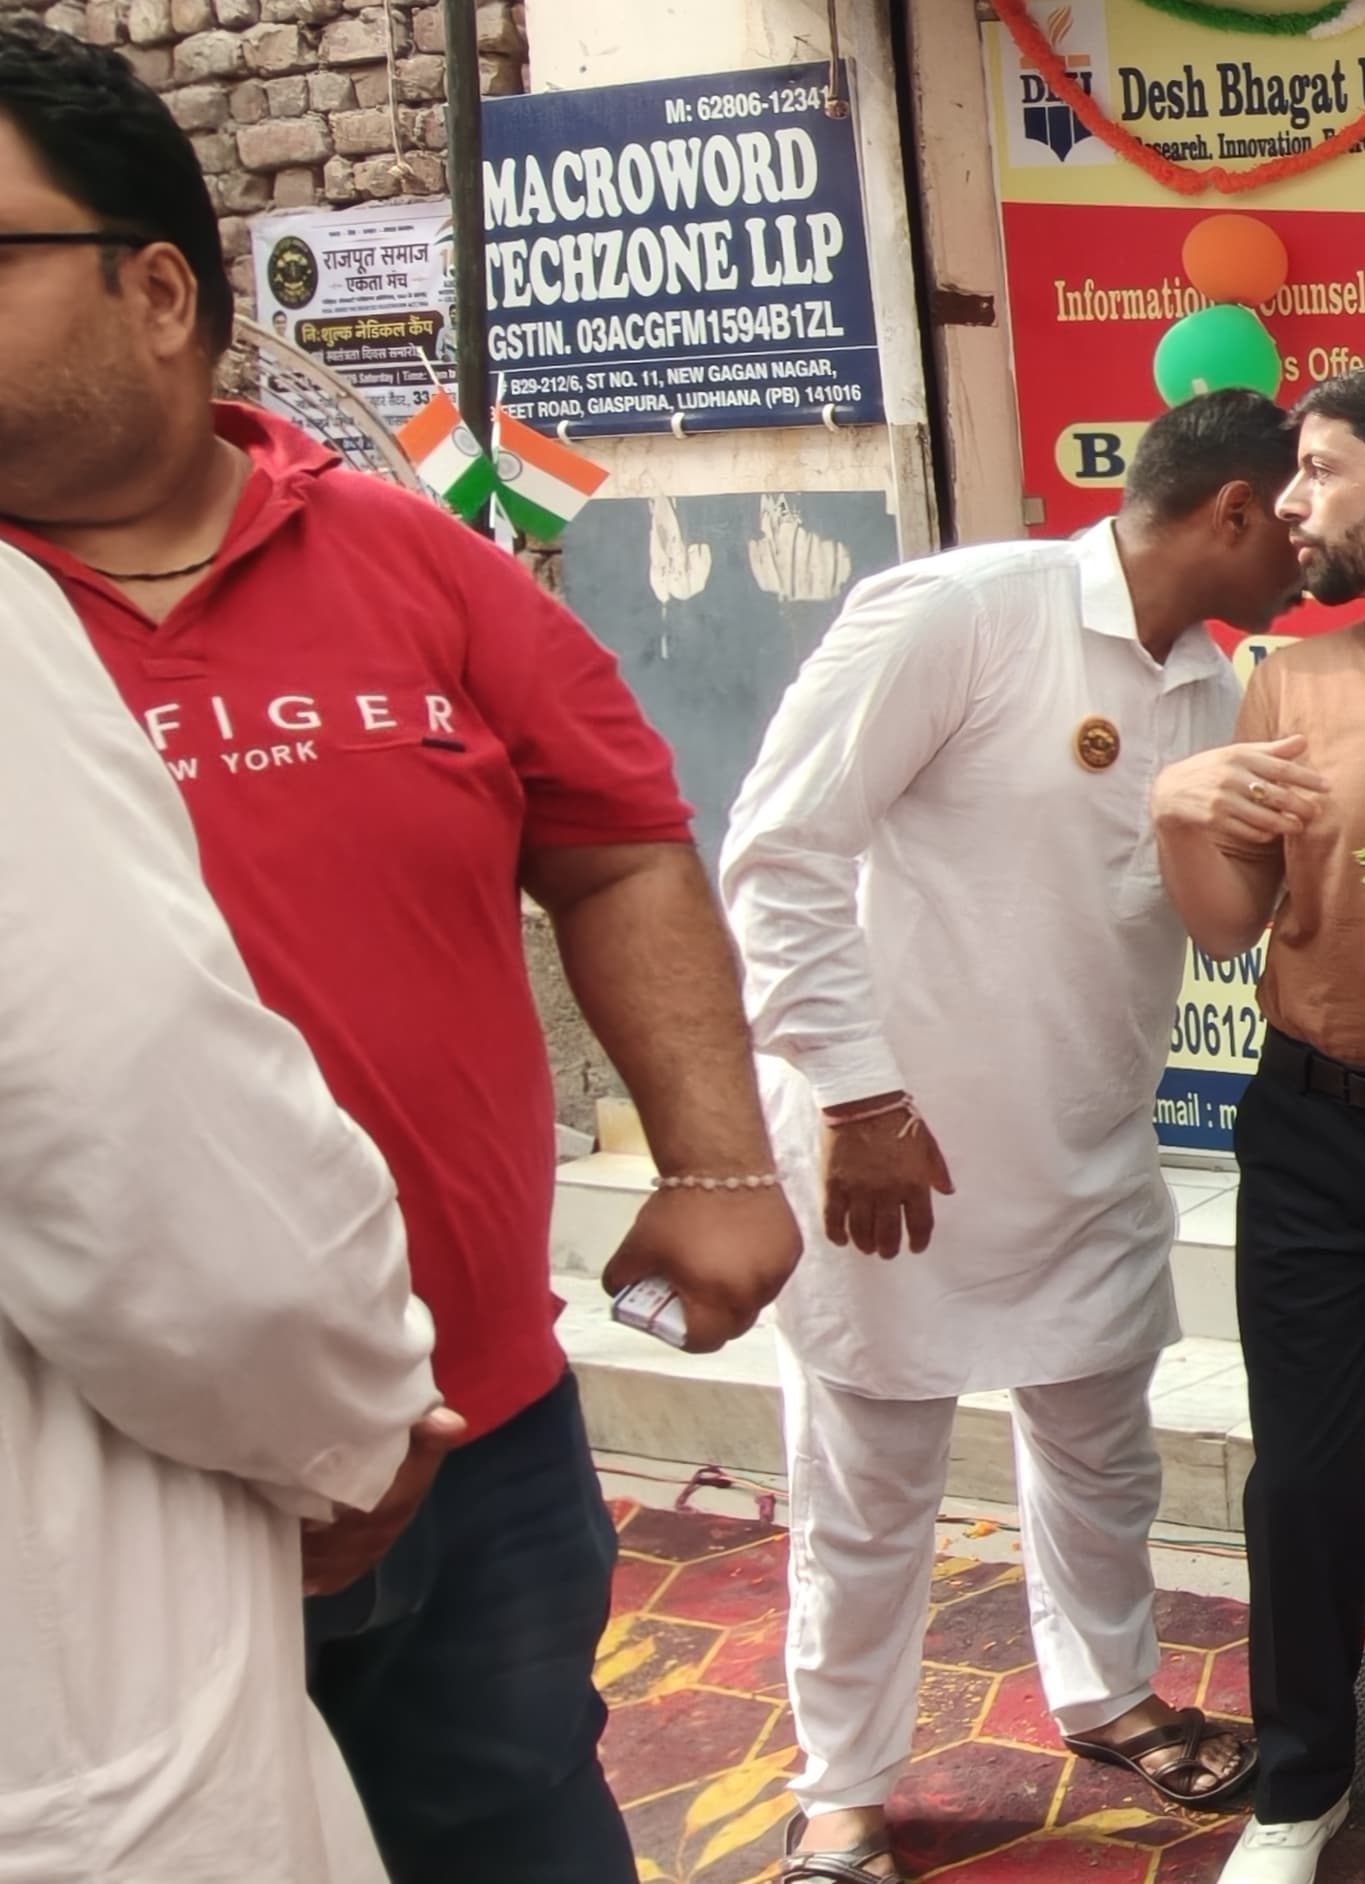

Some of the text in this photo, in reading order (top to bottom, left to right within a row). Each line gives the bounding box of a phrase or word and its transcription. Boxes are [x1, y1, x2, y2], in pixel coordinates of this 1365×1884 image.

[665, 98, 693, 124] M:
[1117, 63, 1209, 121] Desh
[1216, 59, 1349, 129] Bhagat
[482, 127, 818, 231] MACROWORD
[322, 243, 429, 273] राजपूत समाज
[485, 212, 844, 311] TECHZONE LLP
[345, 274, 384, 293] एकता
[1054, 276, 1216, 322] Informatio
[488, 300, 845, 362] GSTIN. 03ACGFM1594B1ZL
[510, 373, 583, 396] B29-212/6,
[586, 374, 605, 390] ST
[608, 372, 638, 388] NO.
[642, 369, 665, 389] 11,
[667, 367, 705, 386] NEW
[708, 364, 769, 384] GAGAN
[770, 359, 837, 381] NAGAR,
[537, 400, 584, 420] ROAD,
[586, 393, 675, 416] GIASPURA,
[677, 388, 762, 411] LUDHIANA
[765, 386, 801, 410] (PB)
[804, 384, 862, 403] 141016
[220, 740, 319, 775] YORK
[1170, 1001, 1268, 1060] 0612
[1151, 1091, 1201, 1128] mail
